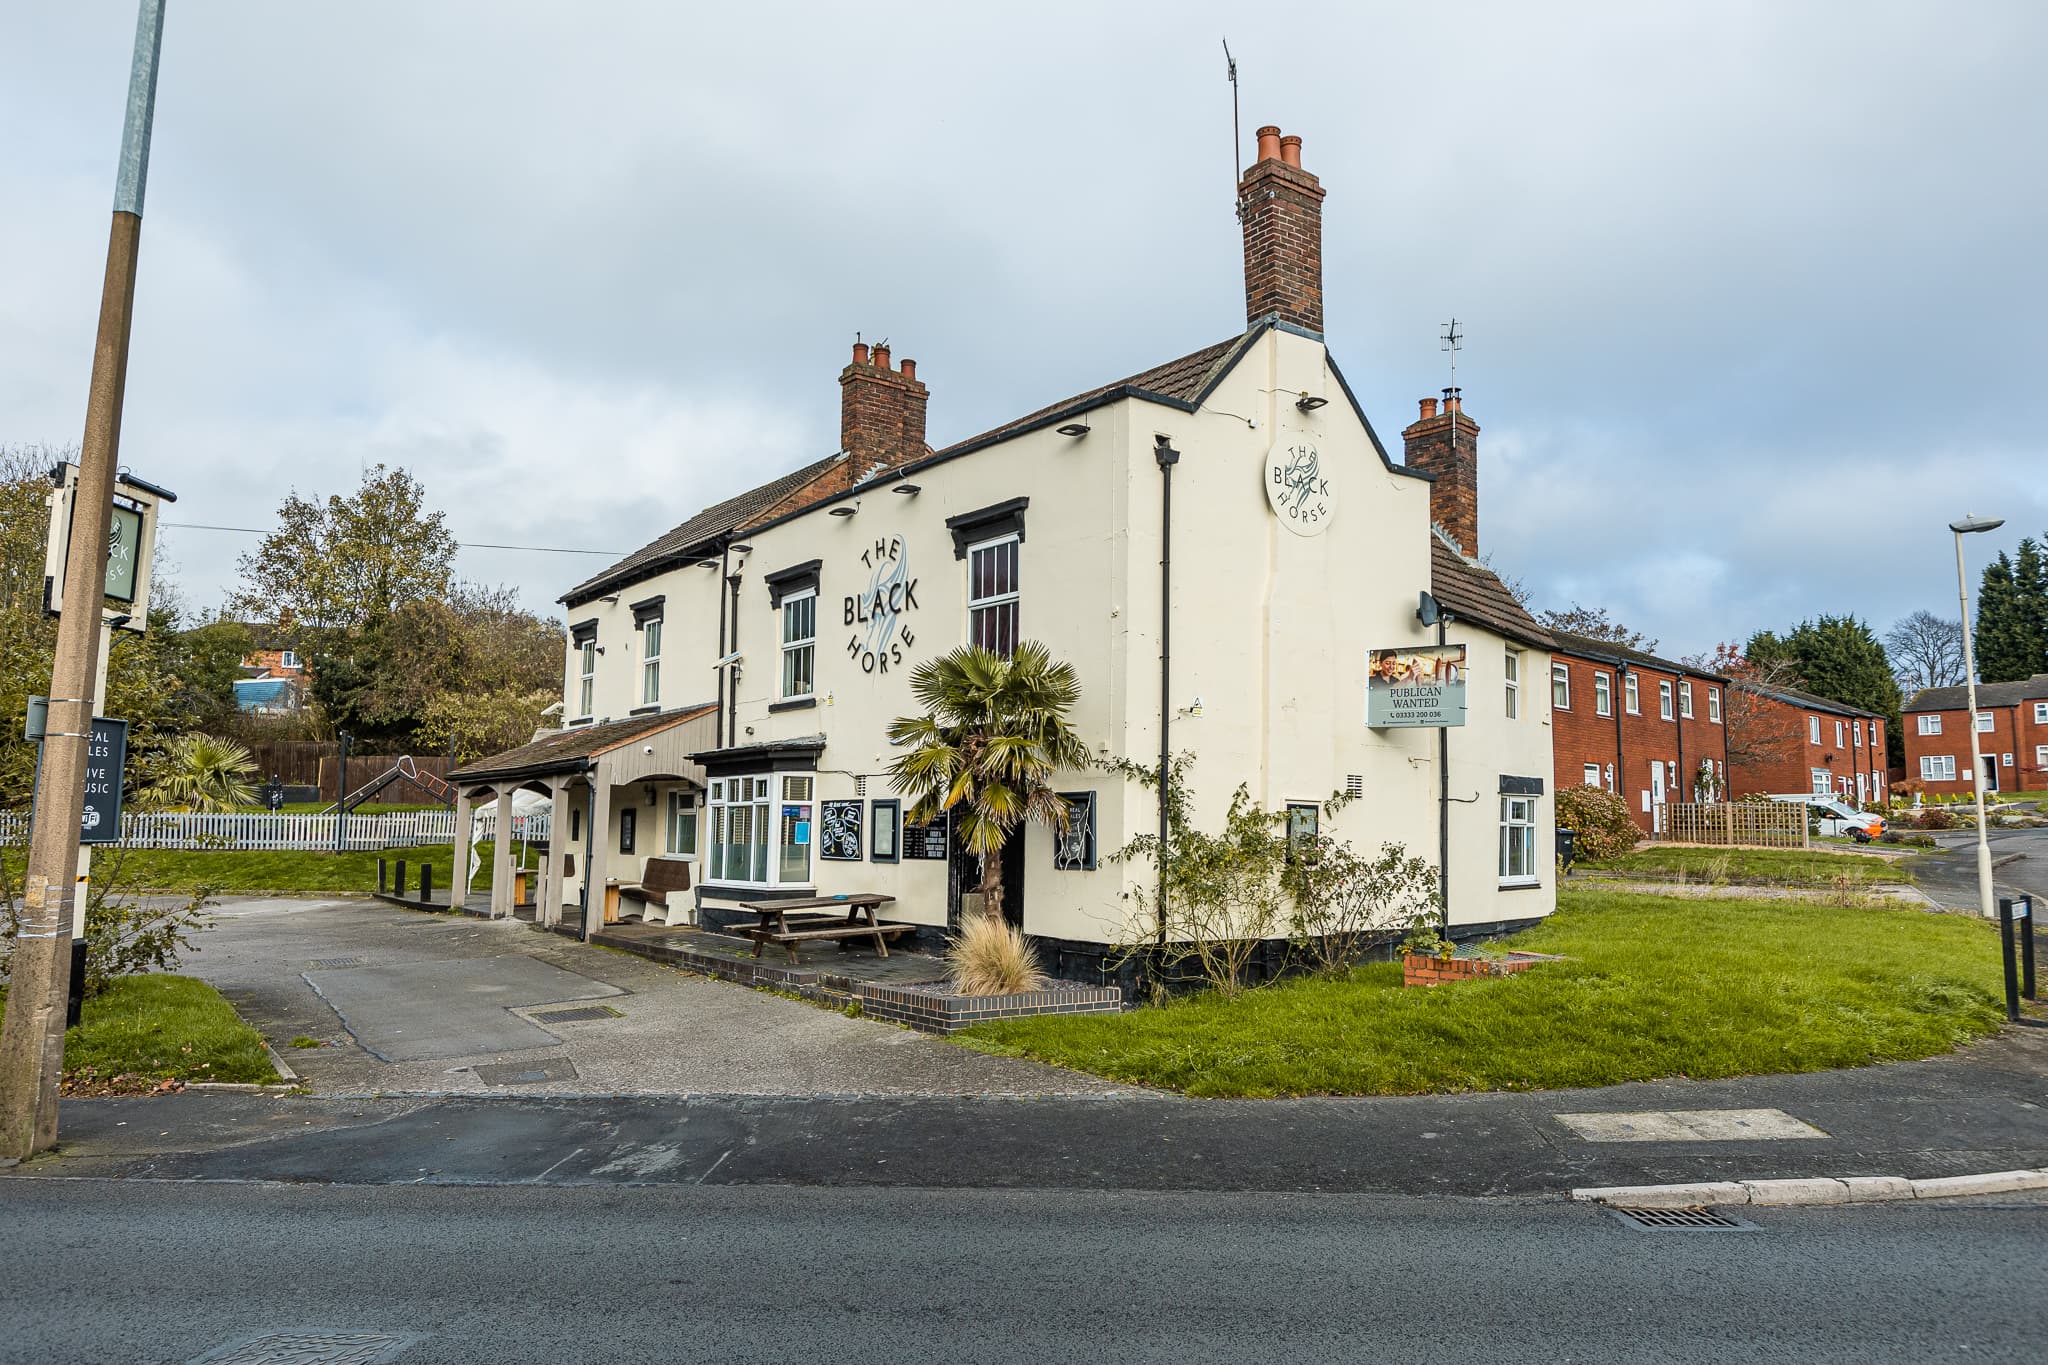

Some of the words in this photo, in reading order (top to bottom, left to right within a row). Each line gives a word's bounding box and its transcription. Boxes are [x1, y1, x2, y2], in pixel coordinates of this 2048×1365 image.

[1287, 445, 1317, 463] THE
[1274, 466, 1329, 497] BLACK
[1277, 491, 1327, 523] HORSE
[861, 537, 900, 569] THE
[844, 578, 919, 626] BLACK
[847, 624, 915, 674] HORSE
[1390, 686, 1442, 697] PUBLICAN
[1392, 698, 1439, 708] WANTED
[88, 731, 109, 743] EAL
[88, 746, 109, 757] LES
[86, 767, 106, 779] IVE
[84, 783, 109, 794] USIC
